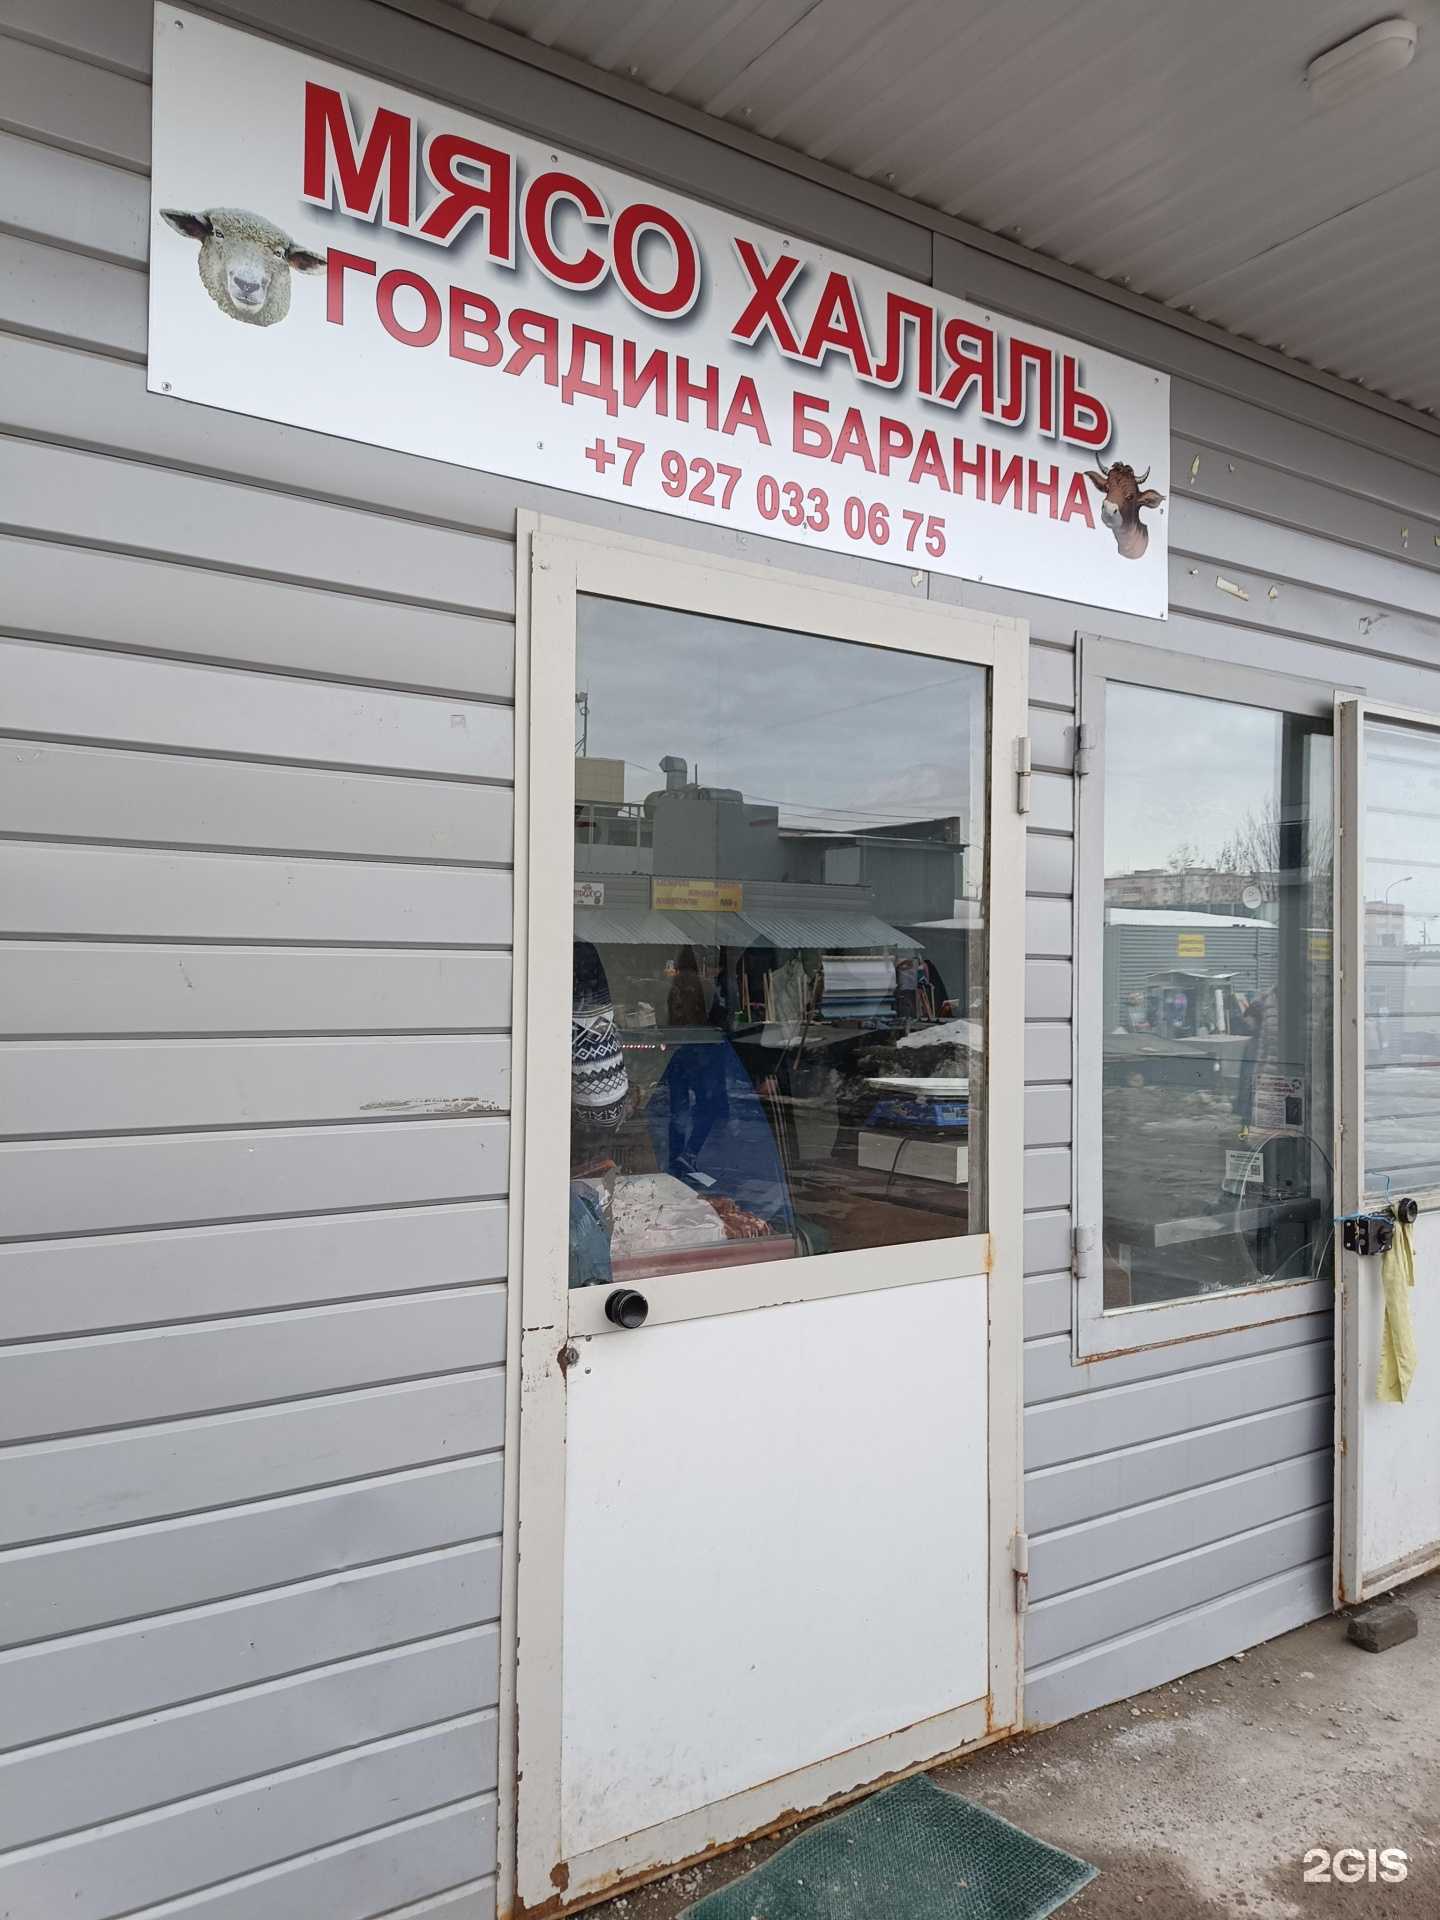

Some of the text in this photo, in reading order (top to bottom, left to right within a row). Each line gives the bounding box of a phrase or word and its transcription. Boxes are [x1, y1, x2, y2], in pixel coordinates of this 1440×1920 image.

[303, 81, 1111, 445] МЯСО ХАЛЯЛЬ
[326, 247, 1096, 529] ГОВЯДИНА БАРАНИНА
[585, 437, 947, 558] +7 927 033 06 75
